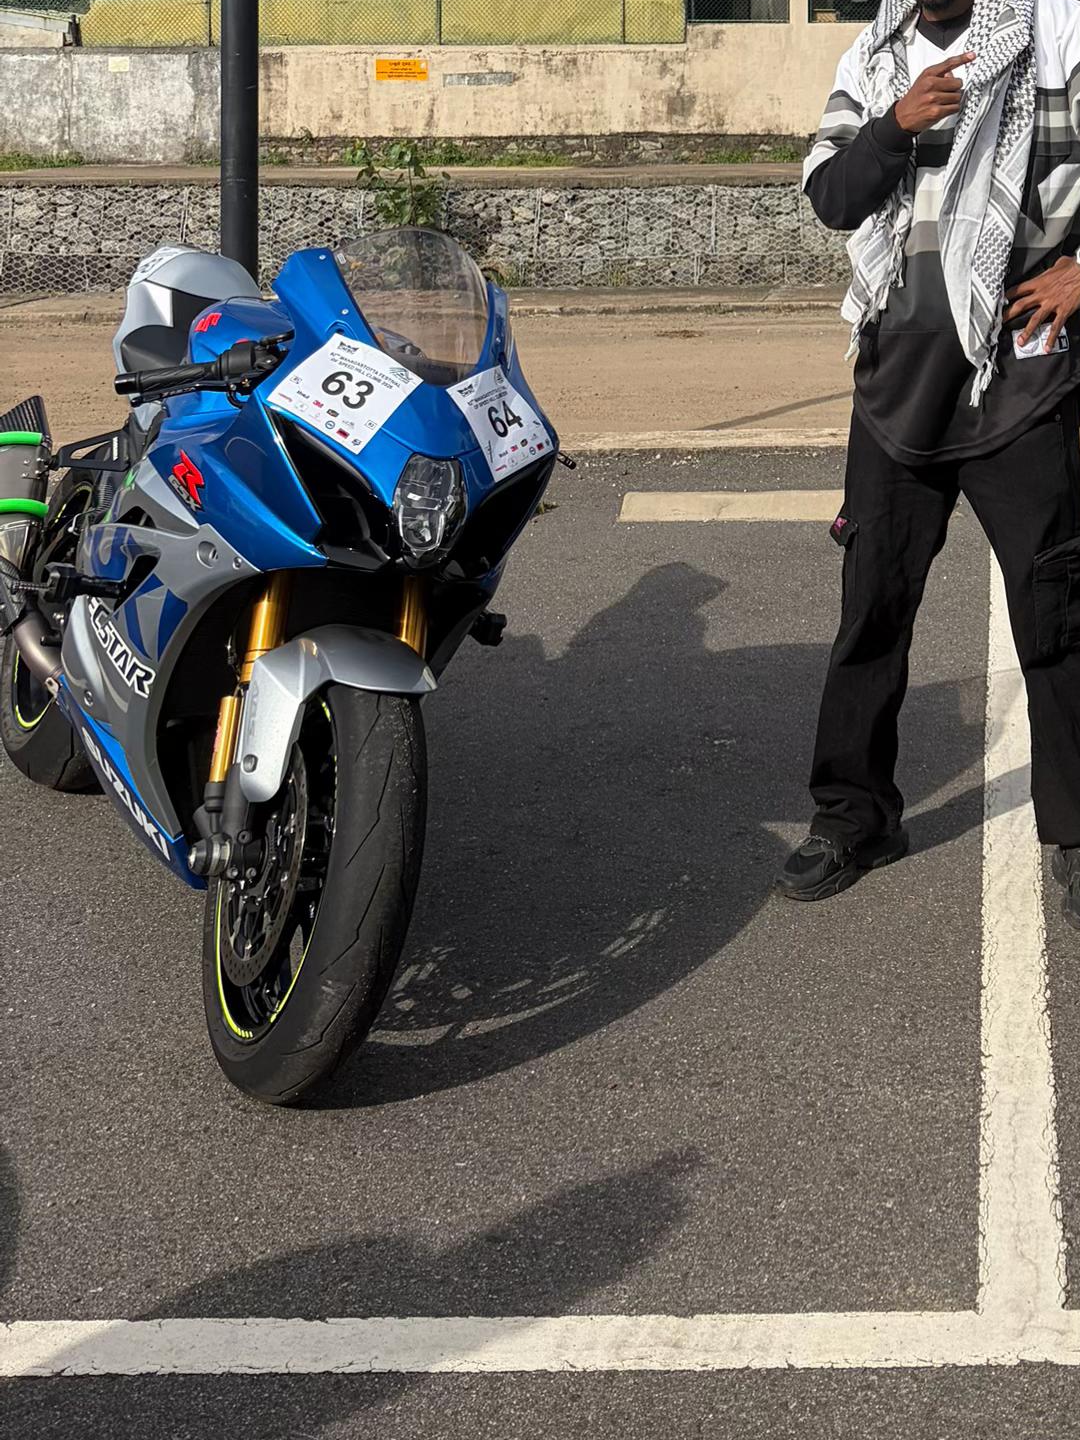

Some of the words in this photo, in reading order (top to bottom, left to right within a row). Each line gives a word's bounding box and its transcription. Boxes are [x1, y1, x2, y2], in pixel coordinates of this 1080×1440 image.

[321, 370, 375, 410] 63
[487, 399, 524, 439] 64
[82, 726, 171, 862] SUZUKI
